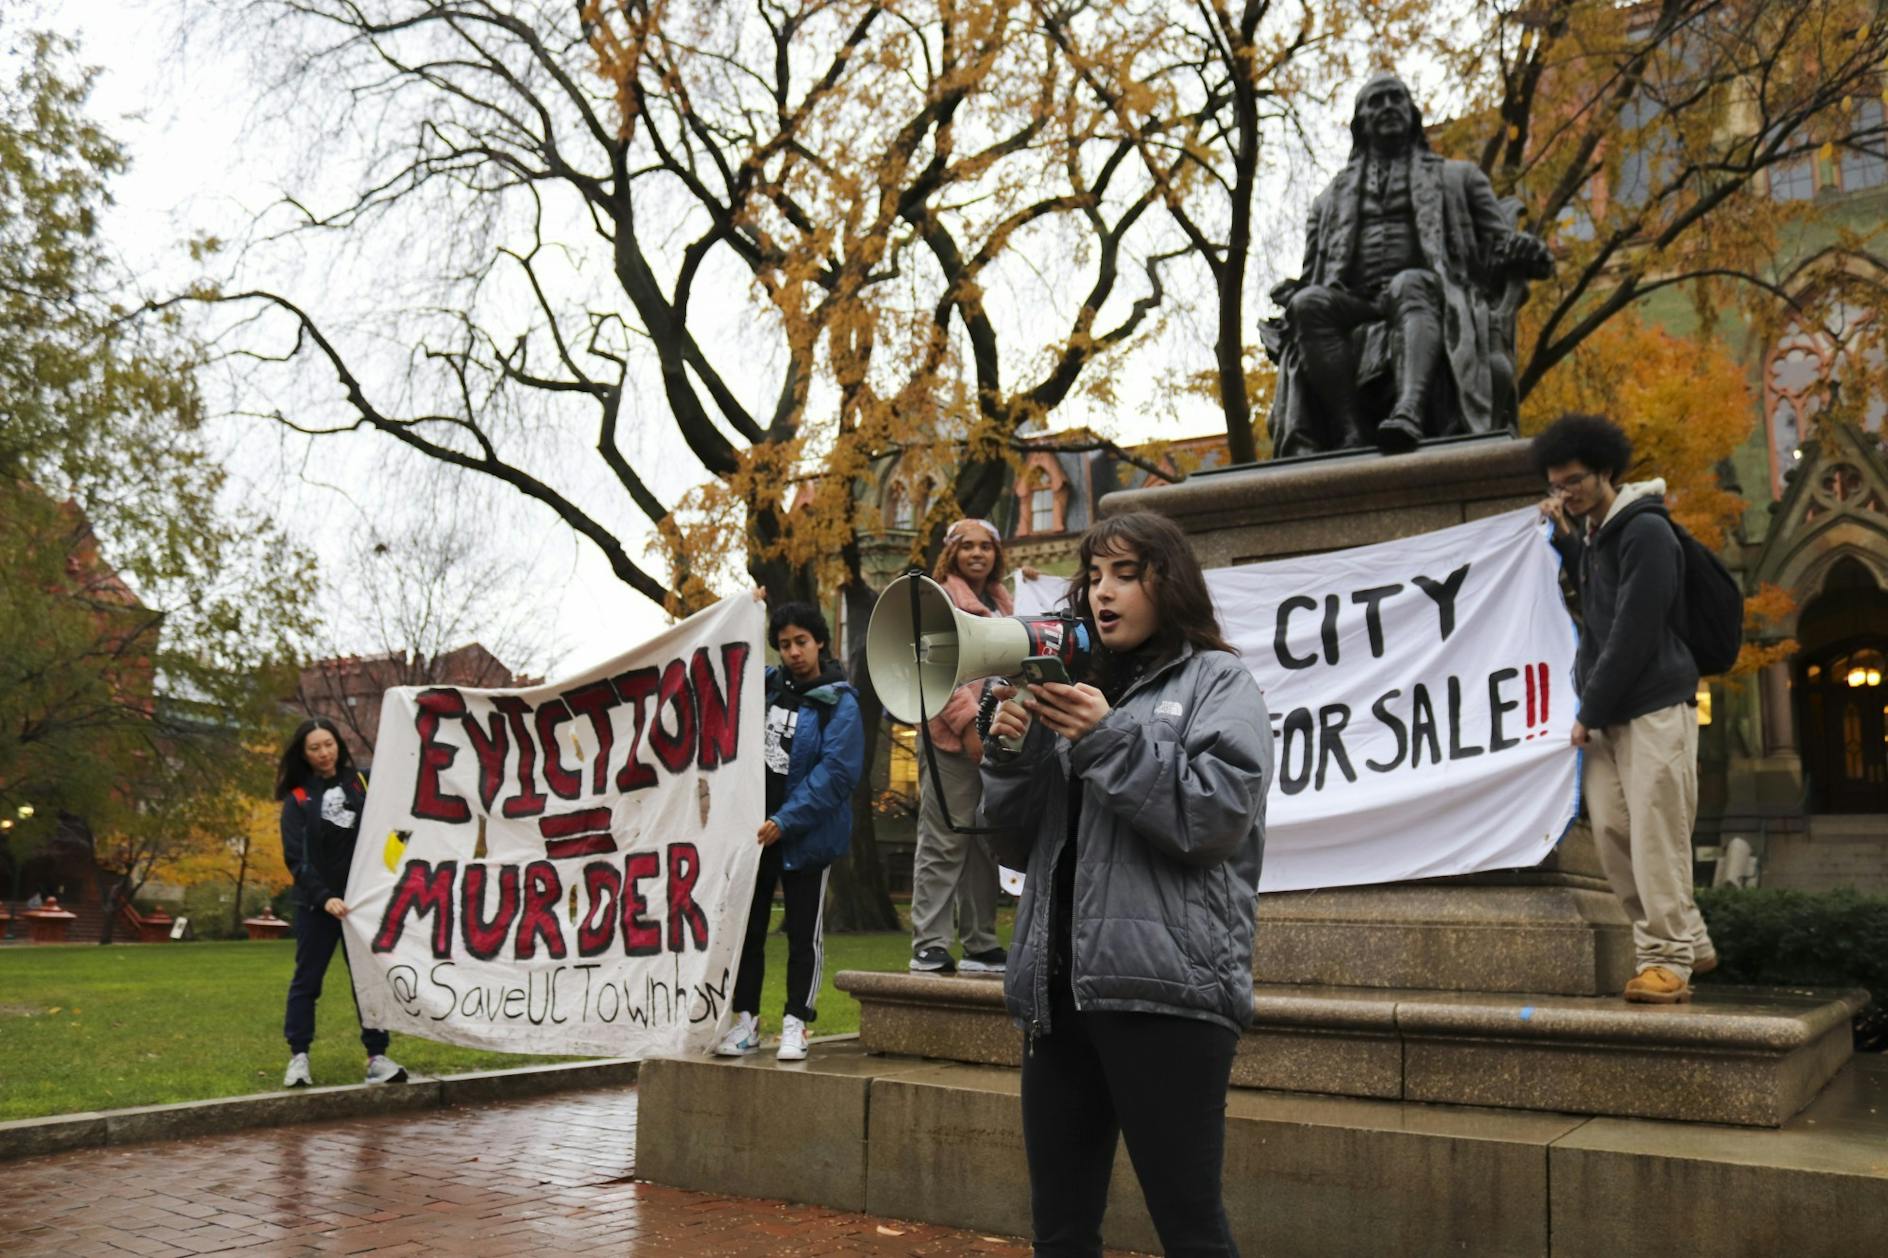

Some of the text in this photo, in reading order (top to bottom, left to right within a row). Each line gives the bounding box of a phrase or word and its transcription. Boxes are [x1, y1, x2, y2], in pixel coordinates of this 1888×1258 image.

[1273, 562, 1471, 670] CITY
[411, 641, 750, 824] EVICTION
[1365, 661, 1550, 773] SALE!!
[371, 842, 710, 961] MURDER
